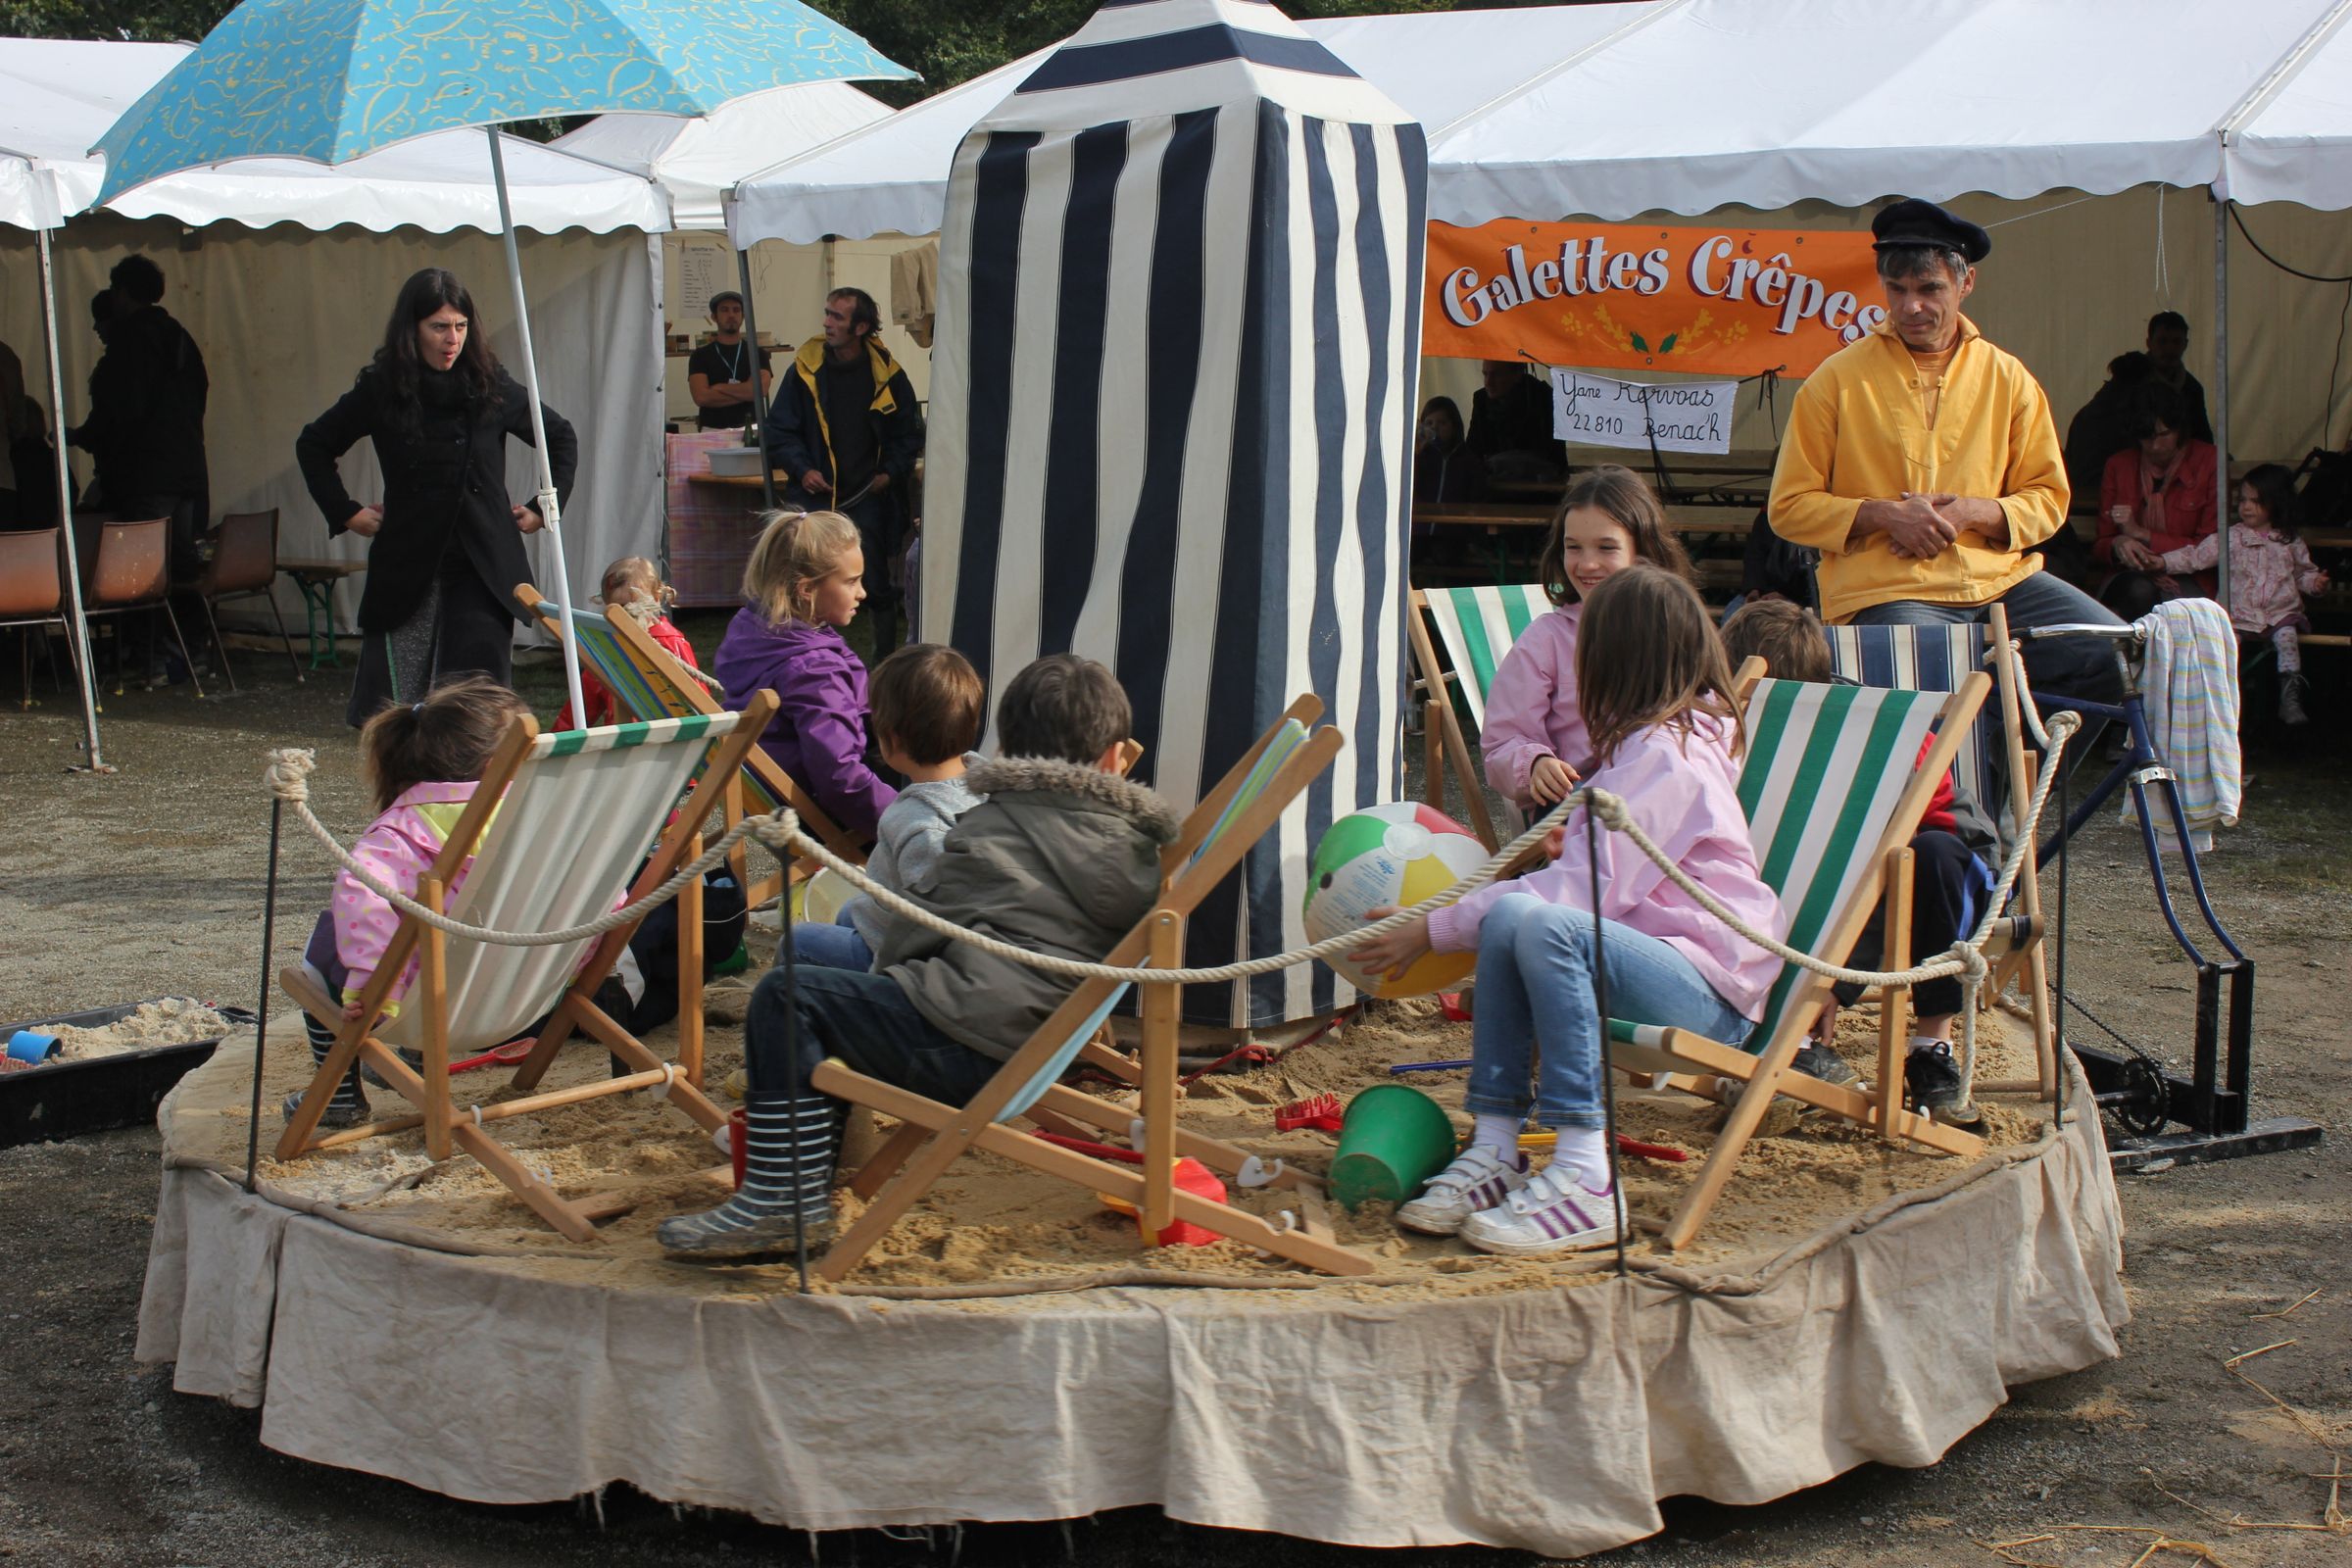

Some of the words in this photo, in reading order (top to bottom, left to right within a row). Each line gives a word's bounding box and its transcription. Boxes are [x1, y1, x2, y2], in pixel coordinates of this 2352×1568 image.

[1442, 235, 1669, 328] Galettes
[1688, 235, 1886, 345] Crêpes
[1560, 373, 1601, 416] Yane
[1573, 413, 1623, 435] 22810
